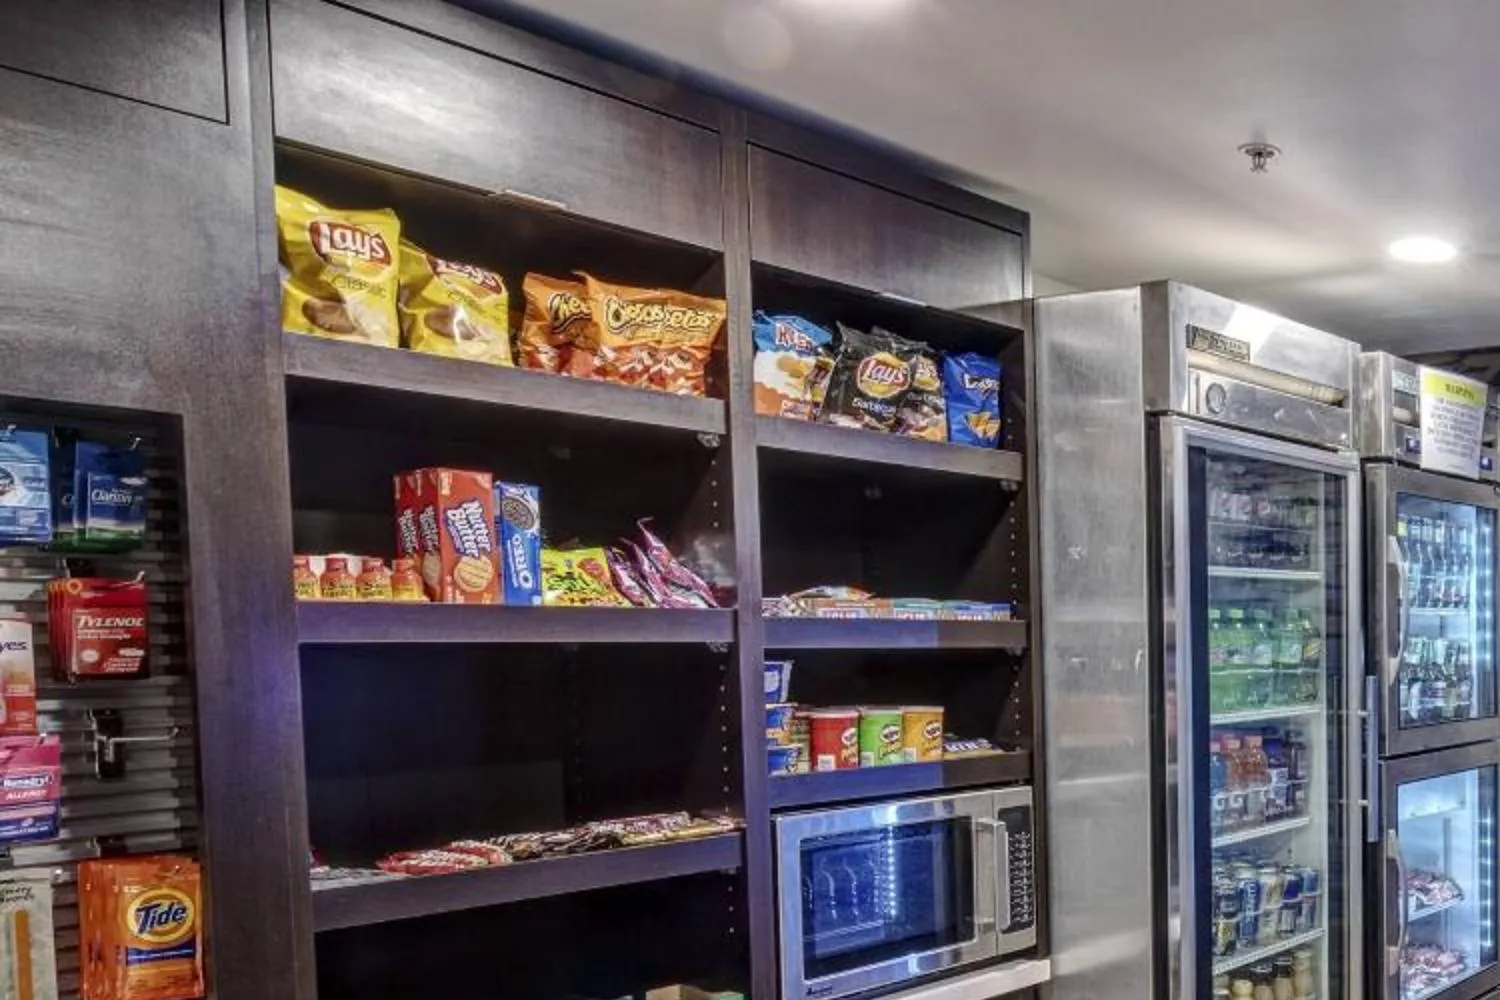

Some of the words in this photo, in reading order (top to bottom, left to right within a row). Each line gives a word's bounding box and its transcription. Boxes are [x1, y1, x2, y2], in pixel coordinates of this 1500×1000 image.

[317, 222, 385, 262] Lay's
[511, 533, 533, 589] OREO
[77, 614, 144, 629] TYLENOL
[136, 902, 187, 934] Tide
